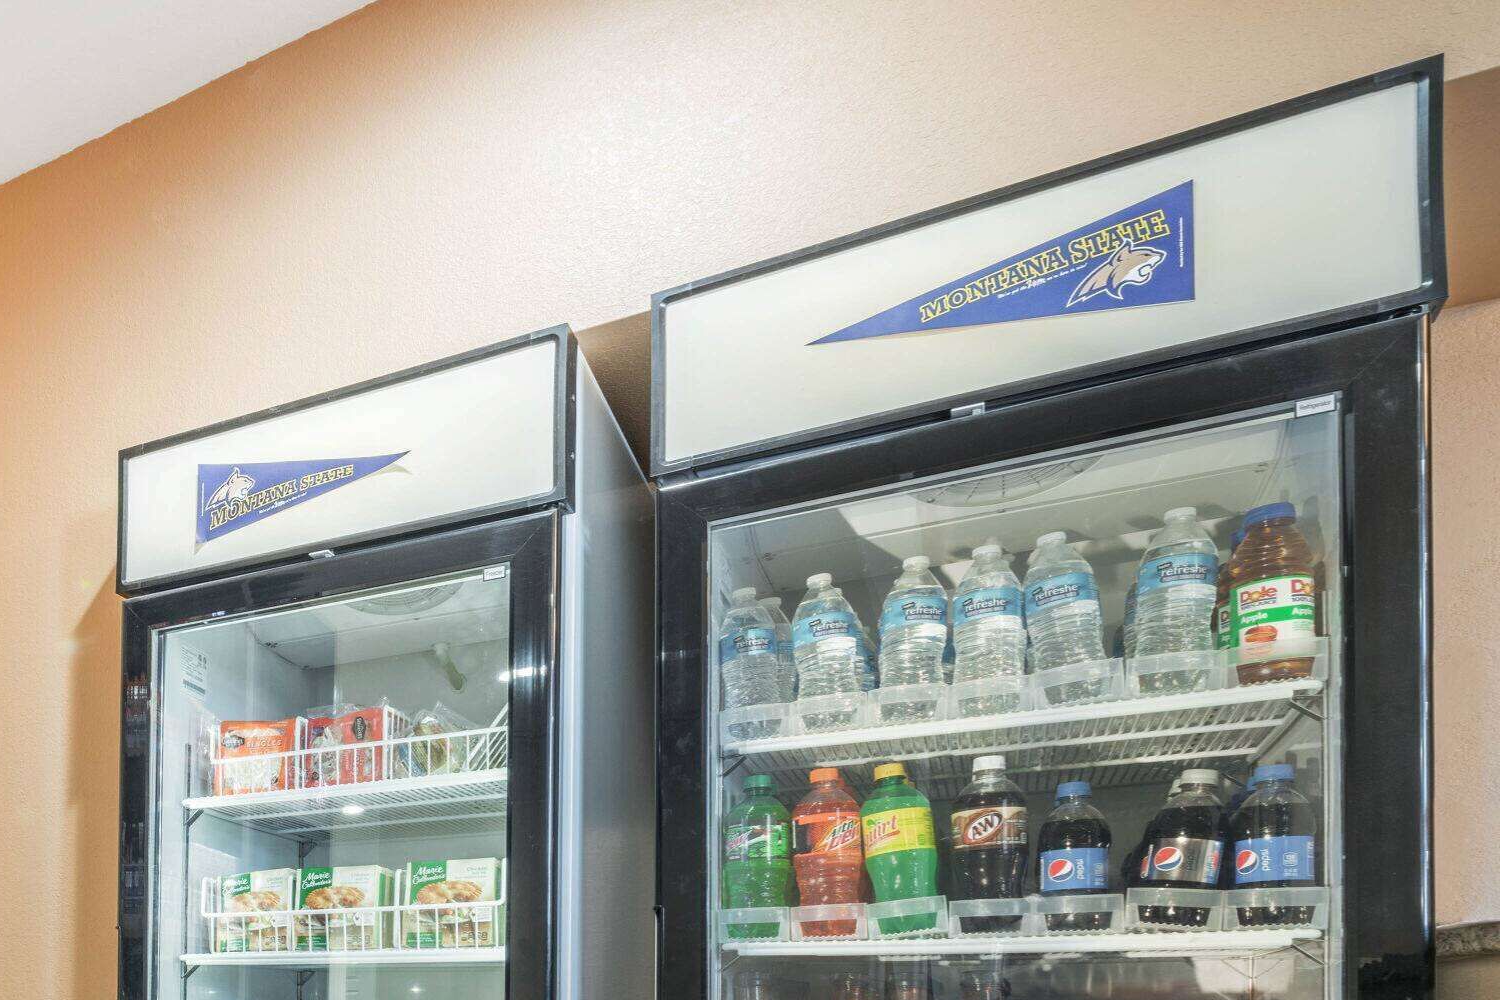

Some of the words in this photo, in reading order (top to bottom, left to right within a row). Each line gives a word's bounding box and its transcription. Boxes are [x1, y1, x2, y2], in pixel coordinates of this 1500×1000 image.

[920, 246, 1068, 323] MONTANA
[1071, 209, 1171, 263] STATE
[210, 480, 297, 530] MONTANA
[299, 465, 353, 491] STATE
[417, 866, 443, 876] Marie
[1260, 849, 1270, 871] pepsi
[307, 872, 331, 882] Marie
